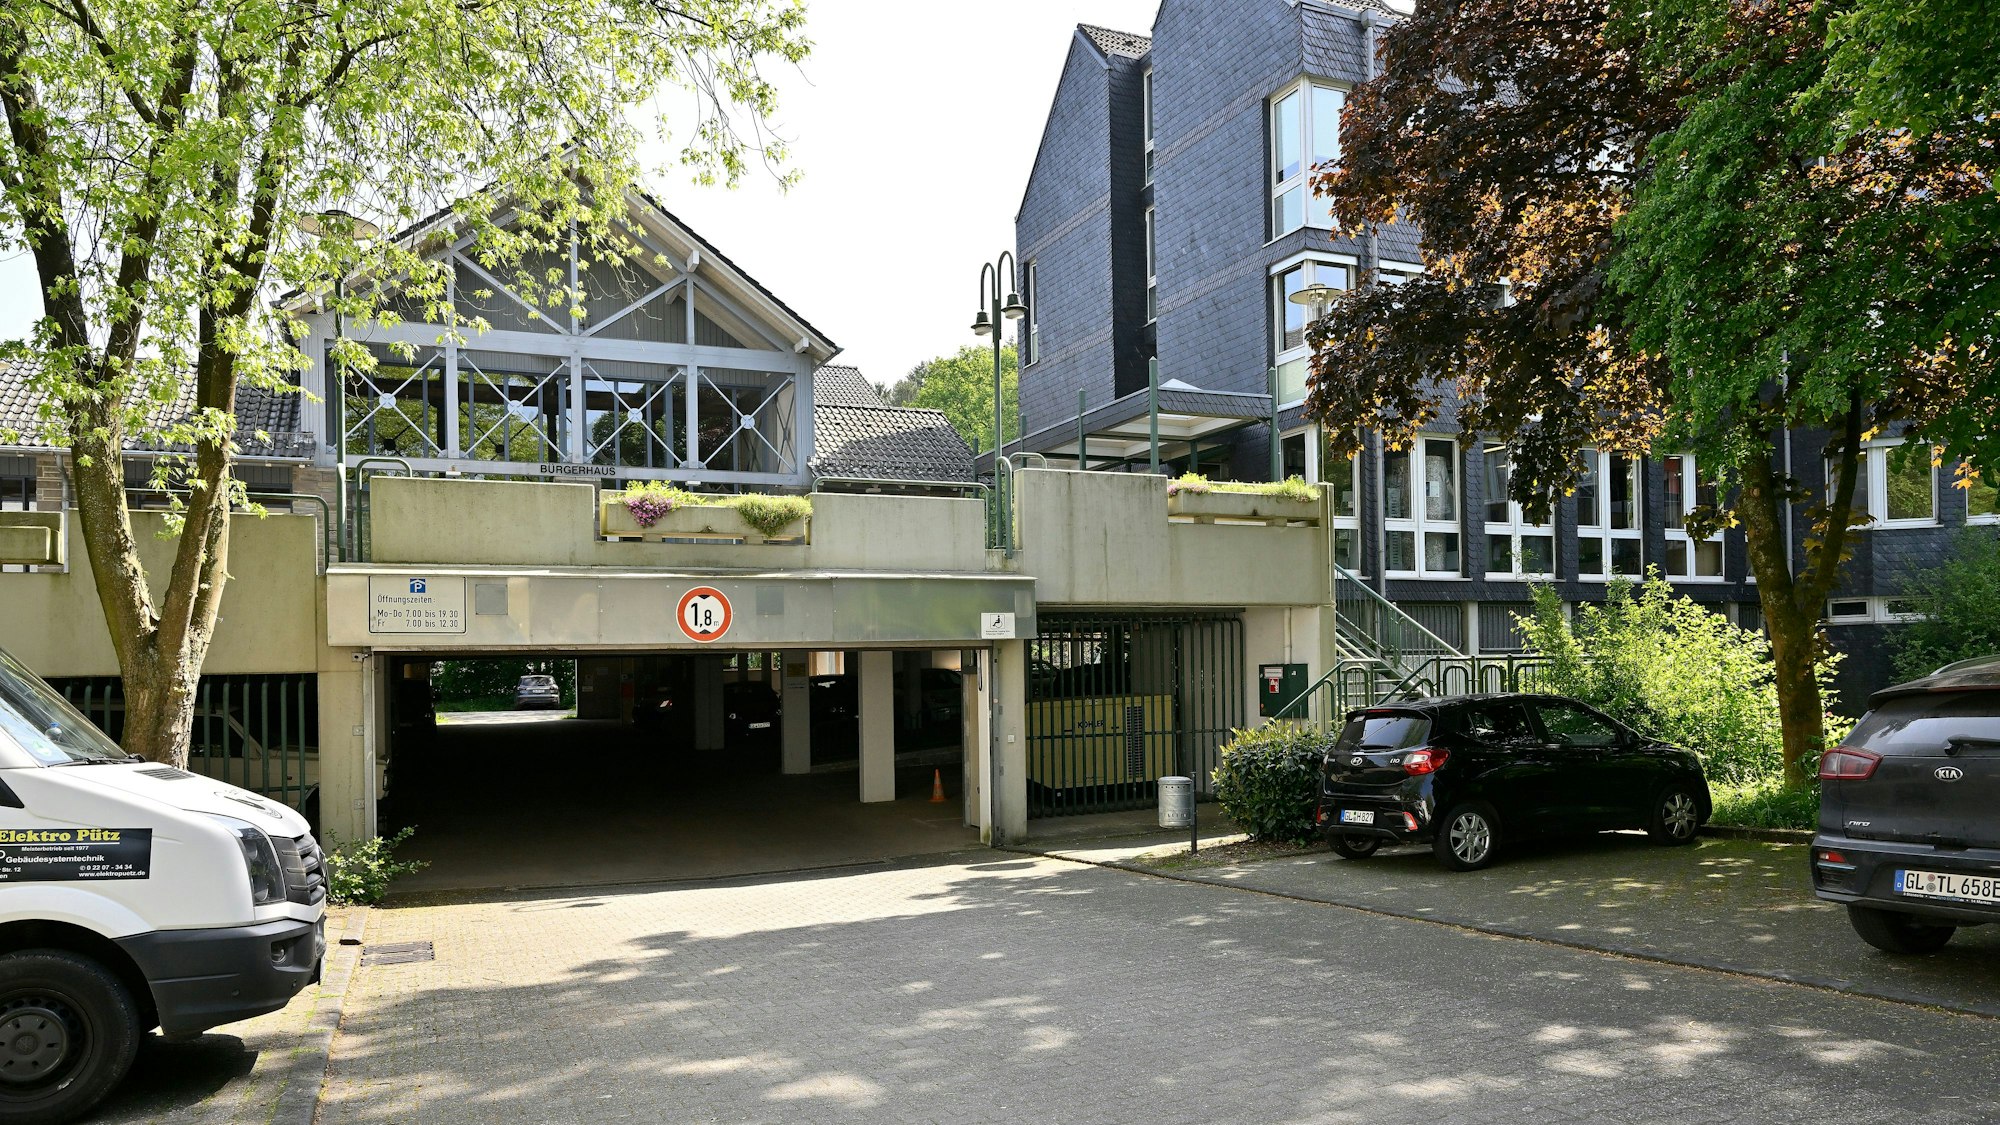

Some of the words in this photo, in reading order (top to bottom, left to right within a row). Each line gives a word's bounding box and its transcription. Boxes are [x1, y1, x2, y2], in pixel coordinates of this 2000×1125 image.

[540, 463, 616, 476] BÜRGERHAUS
[377, 609, 402, 618] Mo-Do
[406, 609, 422, 618] 7.00
[425, 609, 436, 618] bis
[439, 609, 459, 618] 19.30
[691, 602, 712, 627] 1,8
[377, 619, 385, 628] Fr
[406, 619, 422, 628] 7.00
[425, 619, 436, 628] bis
[440, 619, 459, 628] 12.30
[1938, 770, 1958, 778] KIA
[0, 829, 71, 843] Elektro
[76, 828, 121, 842] Pütz
[5, 855, 105, 864] Gebäudesystemtechnik
[78, 870, 146, 878] www.elektropuetz.de
[1906, 873, 1924, 890] GL
[1937, 875, 1956, 894] TL
